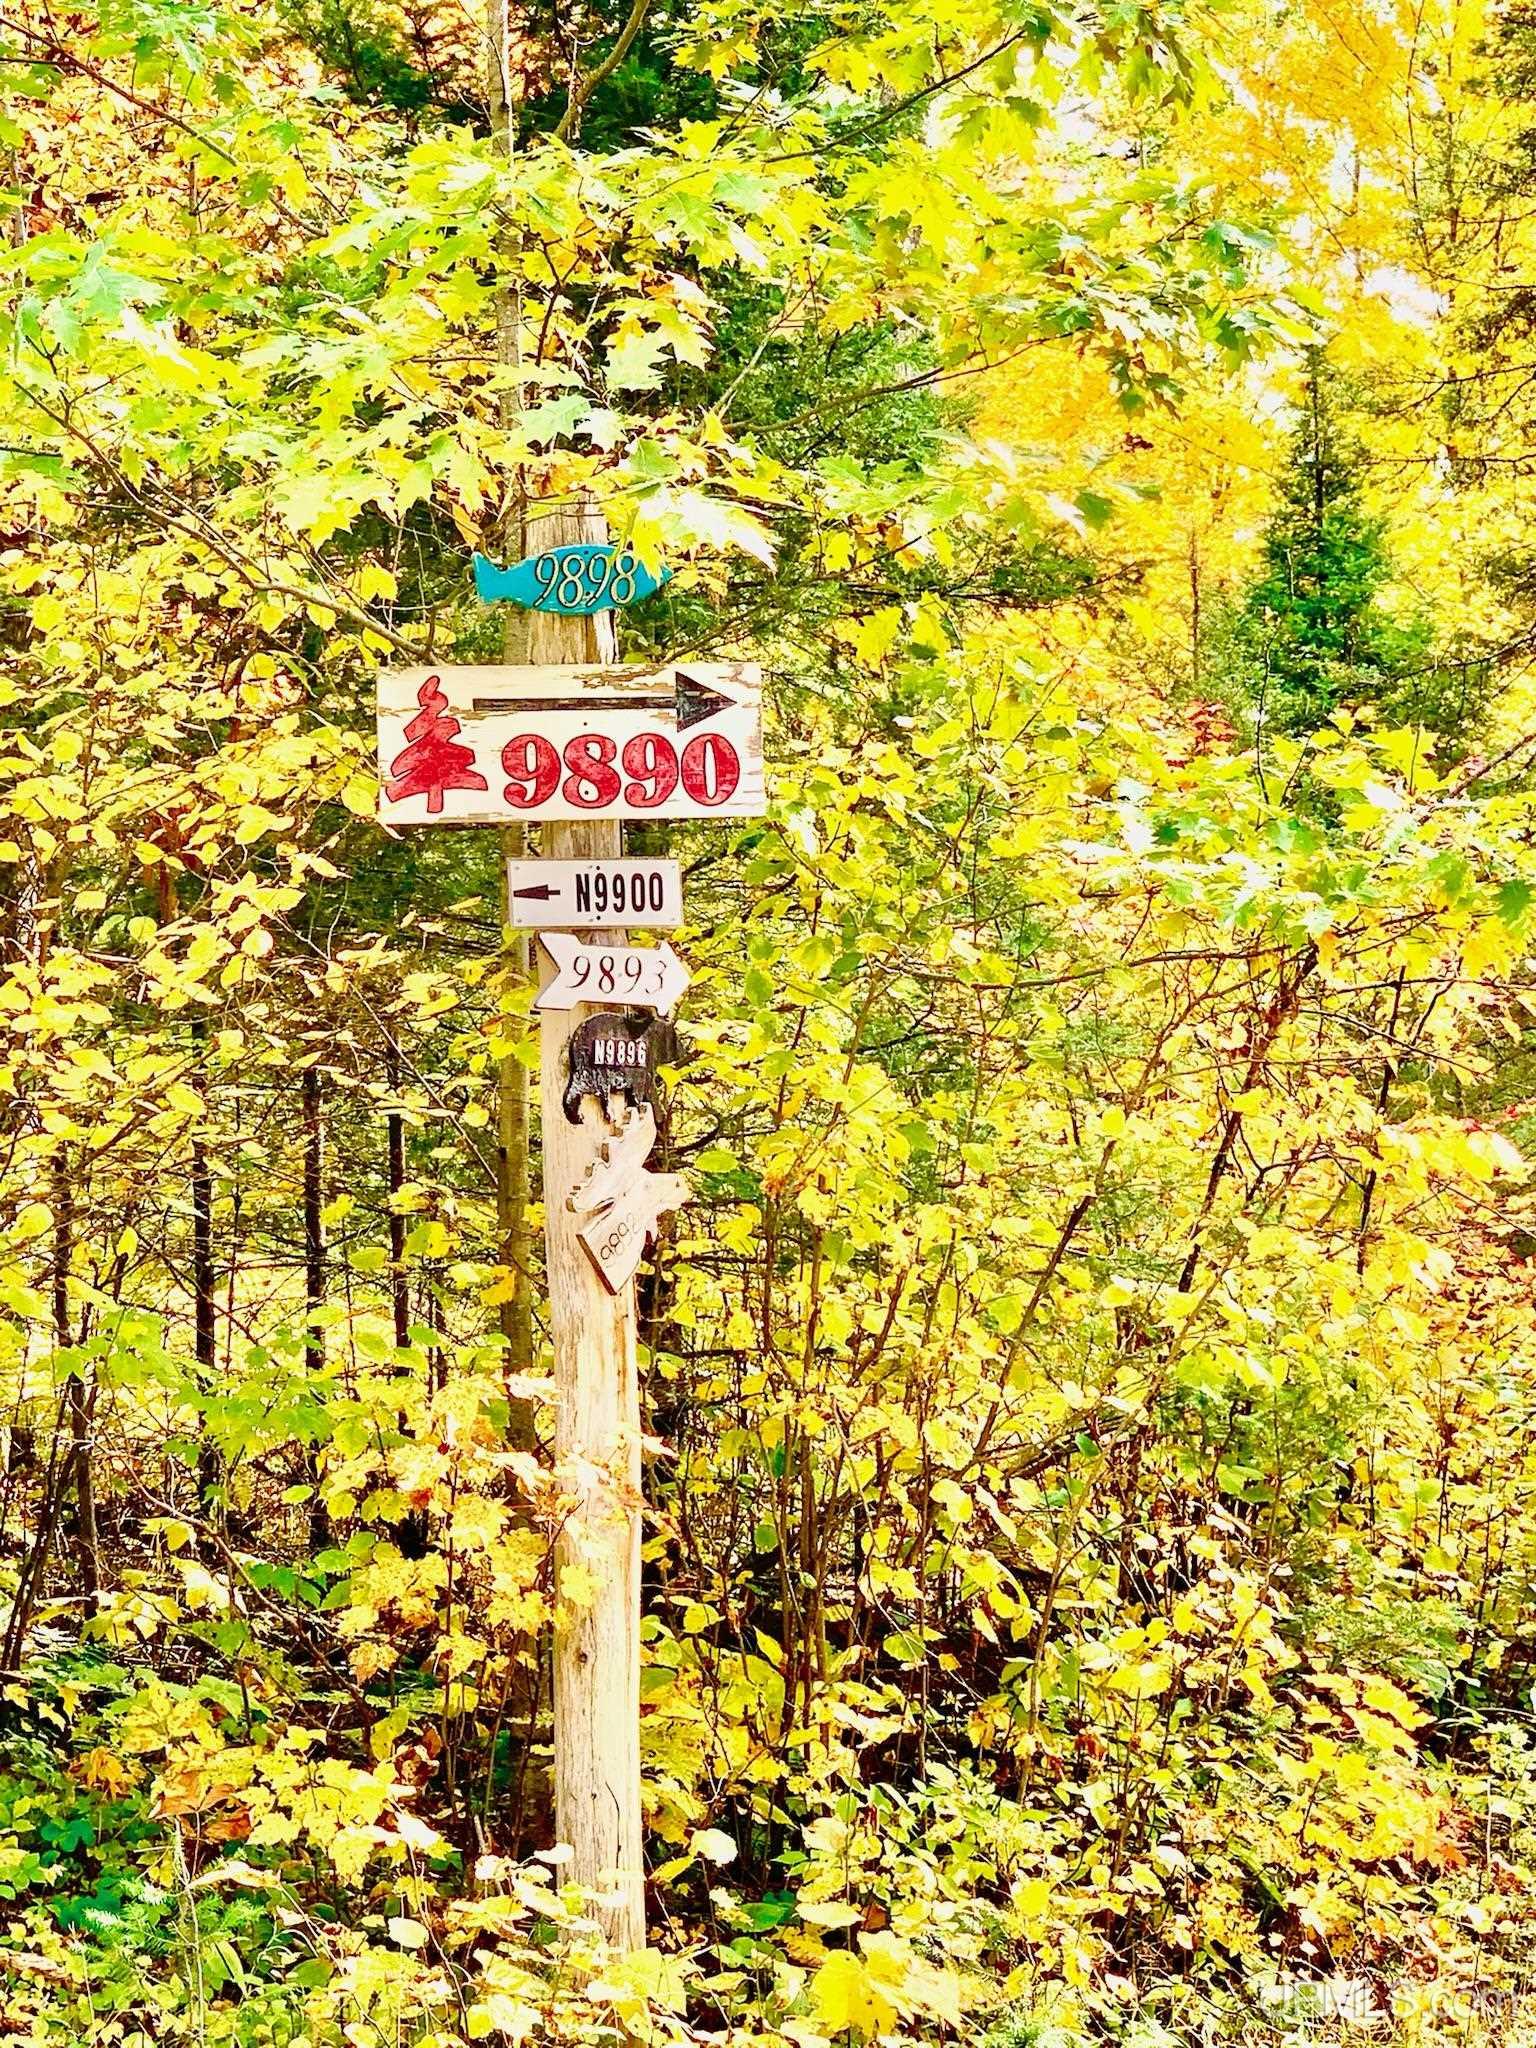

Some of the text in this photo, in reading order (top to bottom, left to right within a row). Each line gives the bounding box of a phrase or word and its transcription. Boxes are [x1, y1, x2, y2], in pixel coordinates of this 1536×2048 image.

[534, 550, 638, 607] 9898
[501, 732, 740, 809] 9890
[575, 872, 664, 913] N9900
[565, 955, 667, 995] 9893
[594, 1039, 647, 1067] N9896
